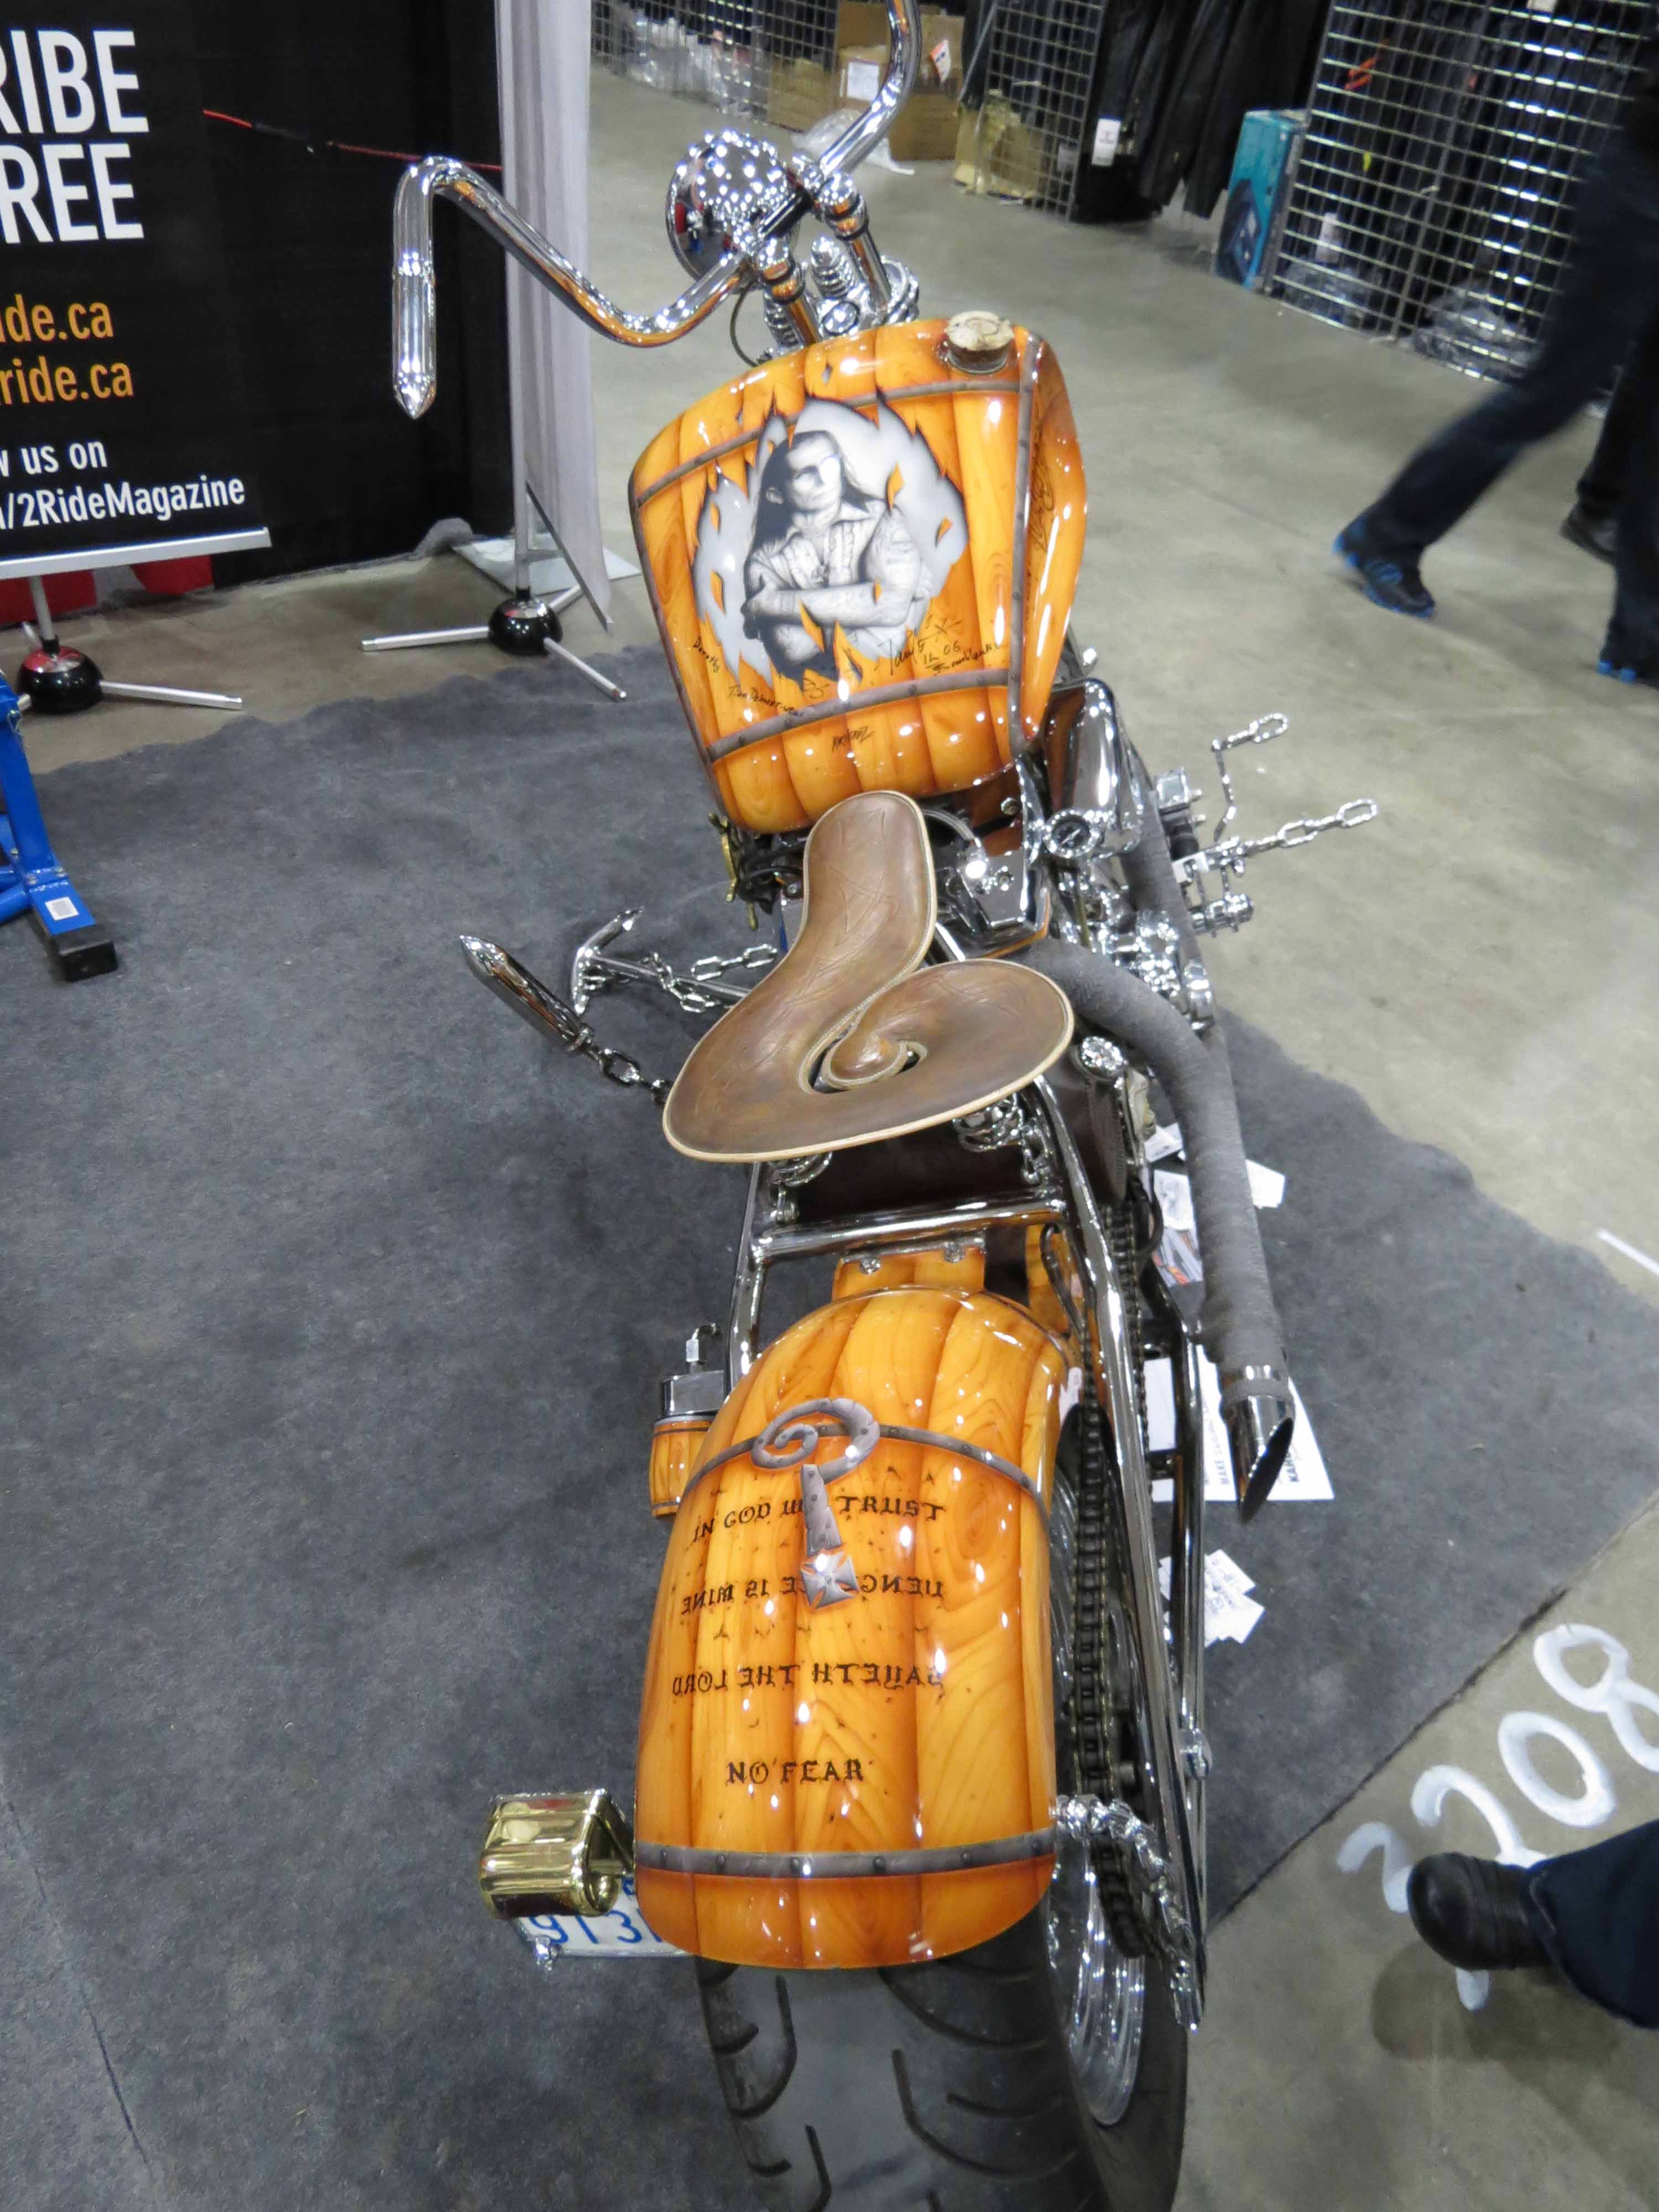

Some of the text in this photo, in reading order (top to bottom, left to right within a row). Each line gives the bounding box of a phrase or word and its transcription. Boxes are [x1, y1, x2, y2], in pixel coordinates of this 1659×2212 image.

[0, 143, 144, 244] REE
[21, 446, 59, 474] us
[70, 441, 107, 469] on
[0, 474, 246, 530] /2RideMagazine
[693, 1517, 714, 1542] IN
[723, 1502, 771, 1528] GOD
[835, 1495, 946, 1521] TRUST
[726, 1757, 864, 1786] NO FEAR
